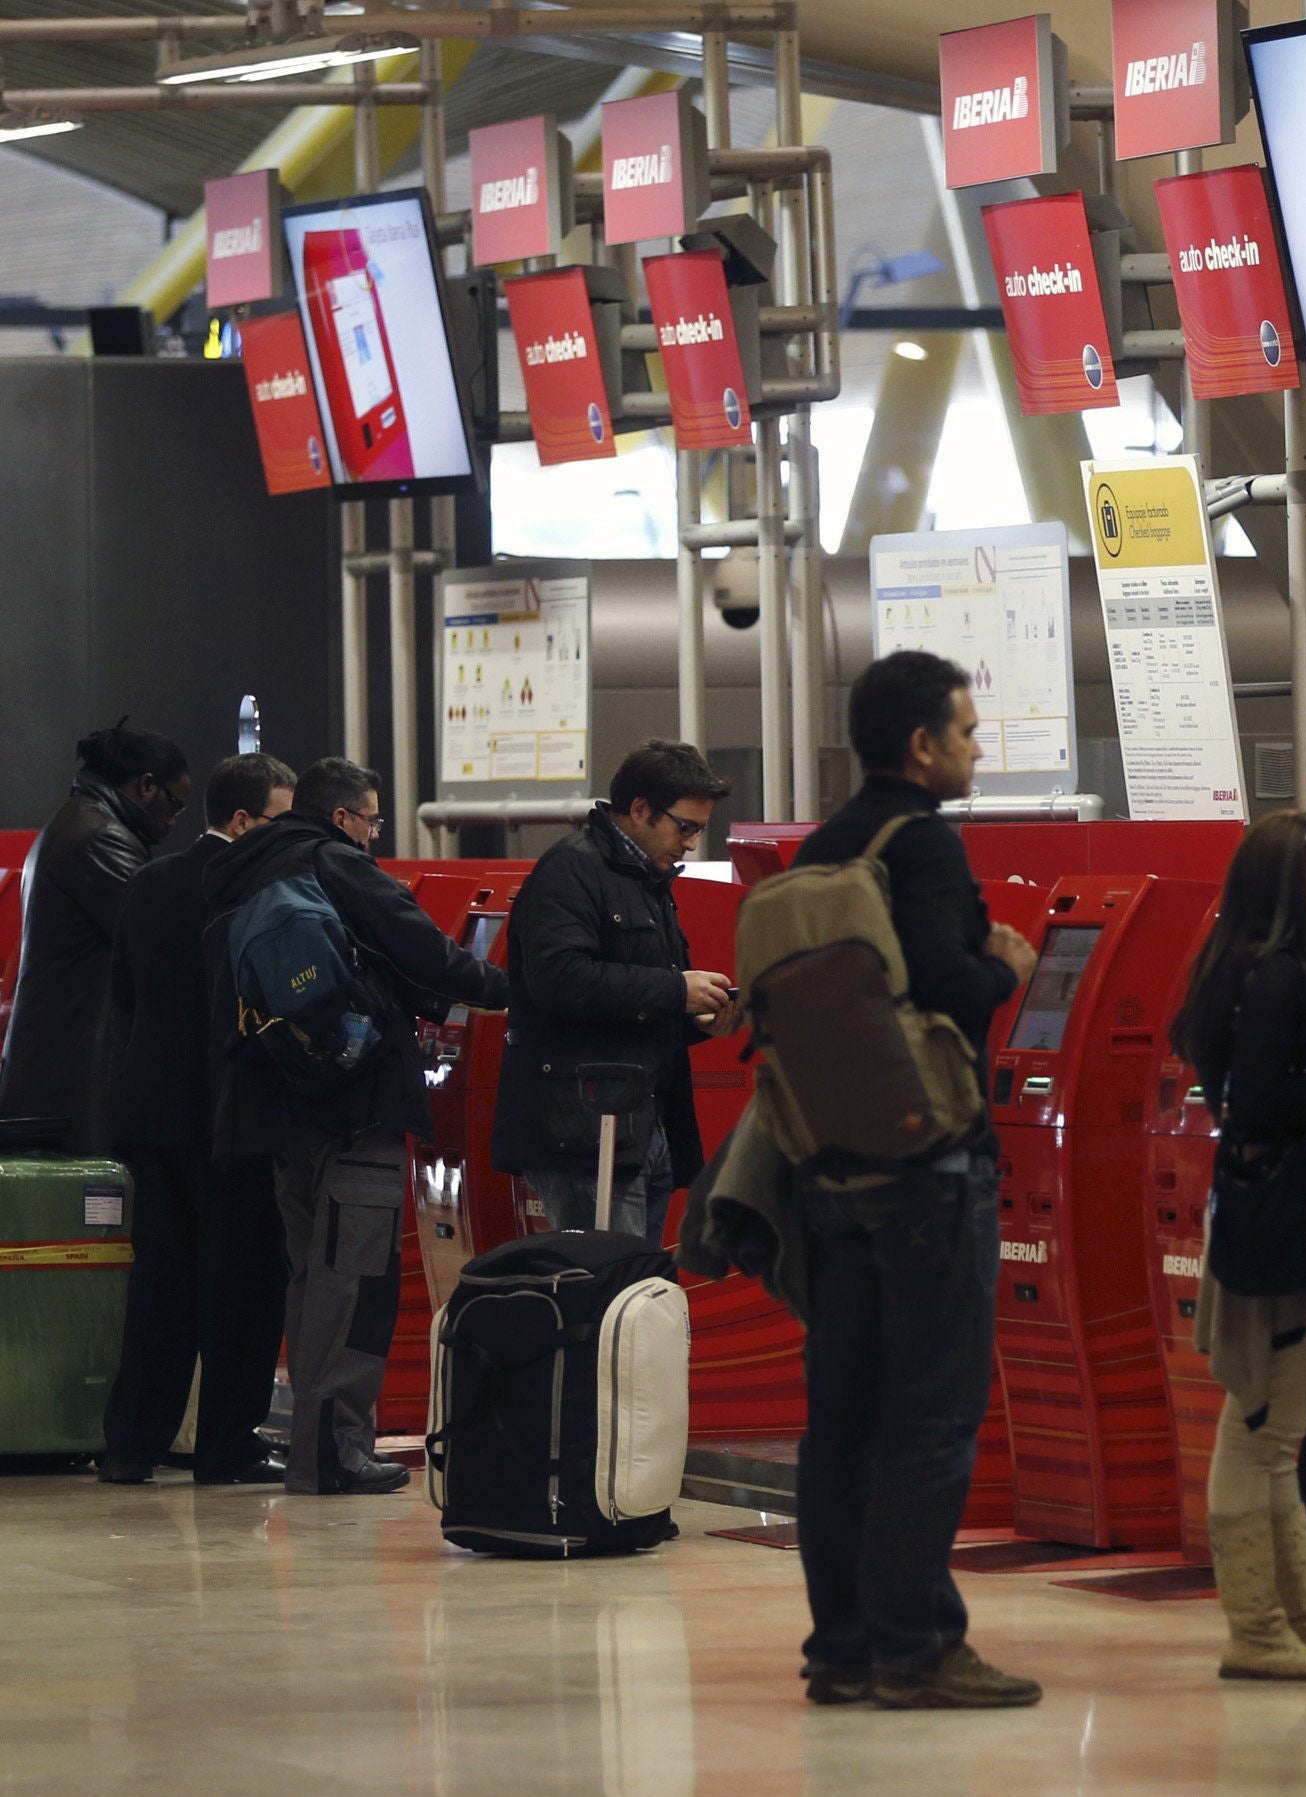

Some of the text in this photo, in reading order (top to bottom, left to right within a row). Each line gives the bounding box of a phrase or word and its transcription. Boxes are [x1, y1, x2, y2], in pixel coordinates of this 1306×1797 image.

[1125, 52, 1190, 97] IBERIA
[952, 87, 1013, 131] IBERIA
[611, 154, 660, 190] IBERIA
[480, 176, 526, 214] IBERIA
[212, 225, 254, 260] IBERIA
[1180, 234, 1261, 273] auto check-in
[1005, 262, 1083, 297] auto check-in
[660, 312, 724, 347] auto check-in
[526, 330, 587, 366] auto check-in
[255, 368, 307, 403] auto check-in
[1213, 789, 1234, 801] IBERIA
[291, 964, 319, 989] ALTUS
[526, 1199, 547, 1218] IBER
[1000, 1241, 1038, 1263] IBERIA
[1163, 1254, 1200, 1278] IBERIA
